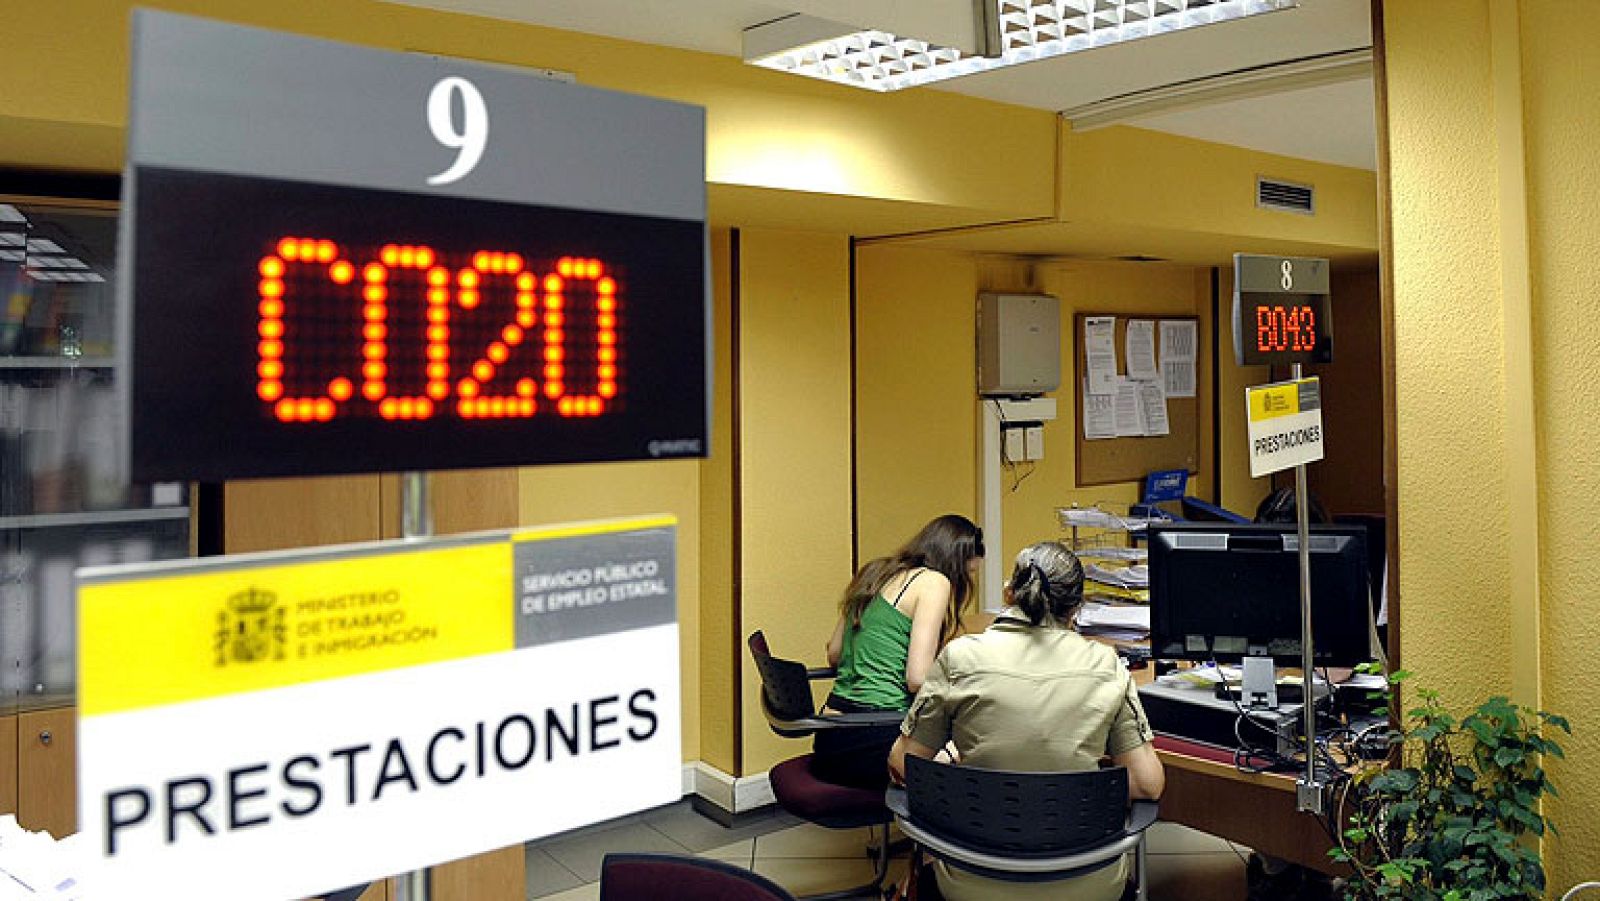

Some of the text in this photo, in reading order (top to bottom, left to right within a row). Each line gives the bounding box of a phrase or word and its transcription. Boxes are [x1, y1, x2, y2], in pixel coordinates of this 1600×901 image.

[426, 76, 489, 186] 9
[1281, 259, 1293, 291] 8
[1257, 305, 1315, 352] B043
[1253, 425, 1320, 456] PRESTACIONES
[522, 558, 659, 594] SERVICIO PÚBLICO
[296, 588, 401, 614] MINISTERIO
[521, 578, 669, 615] DE EMPLEO ESTATAL
[297, 609, 405, 638] DE TRABAJO
[298, 625, 438, 659] E INMIGRACIÓN
[103, 687, 660, 857] PRESTACIONES
